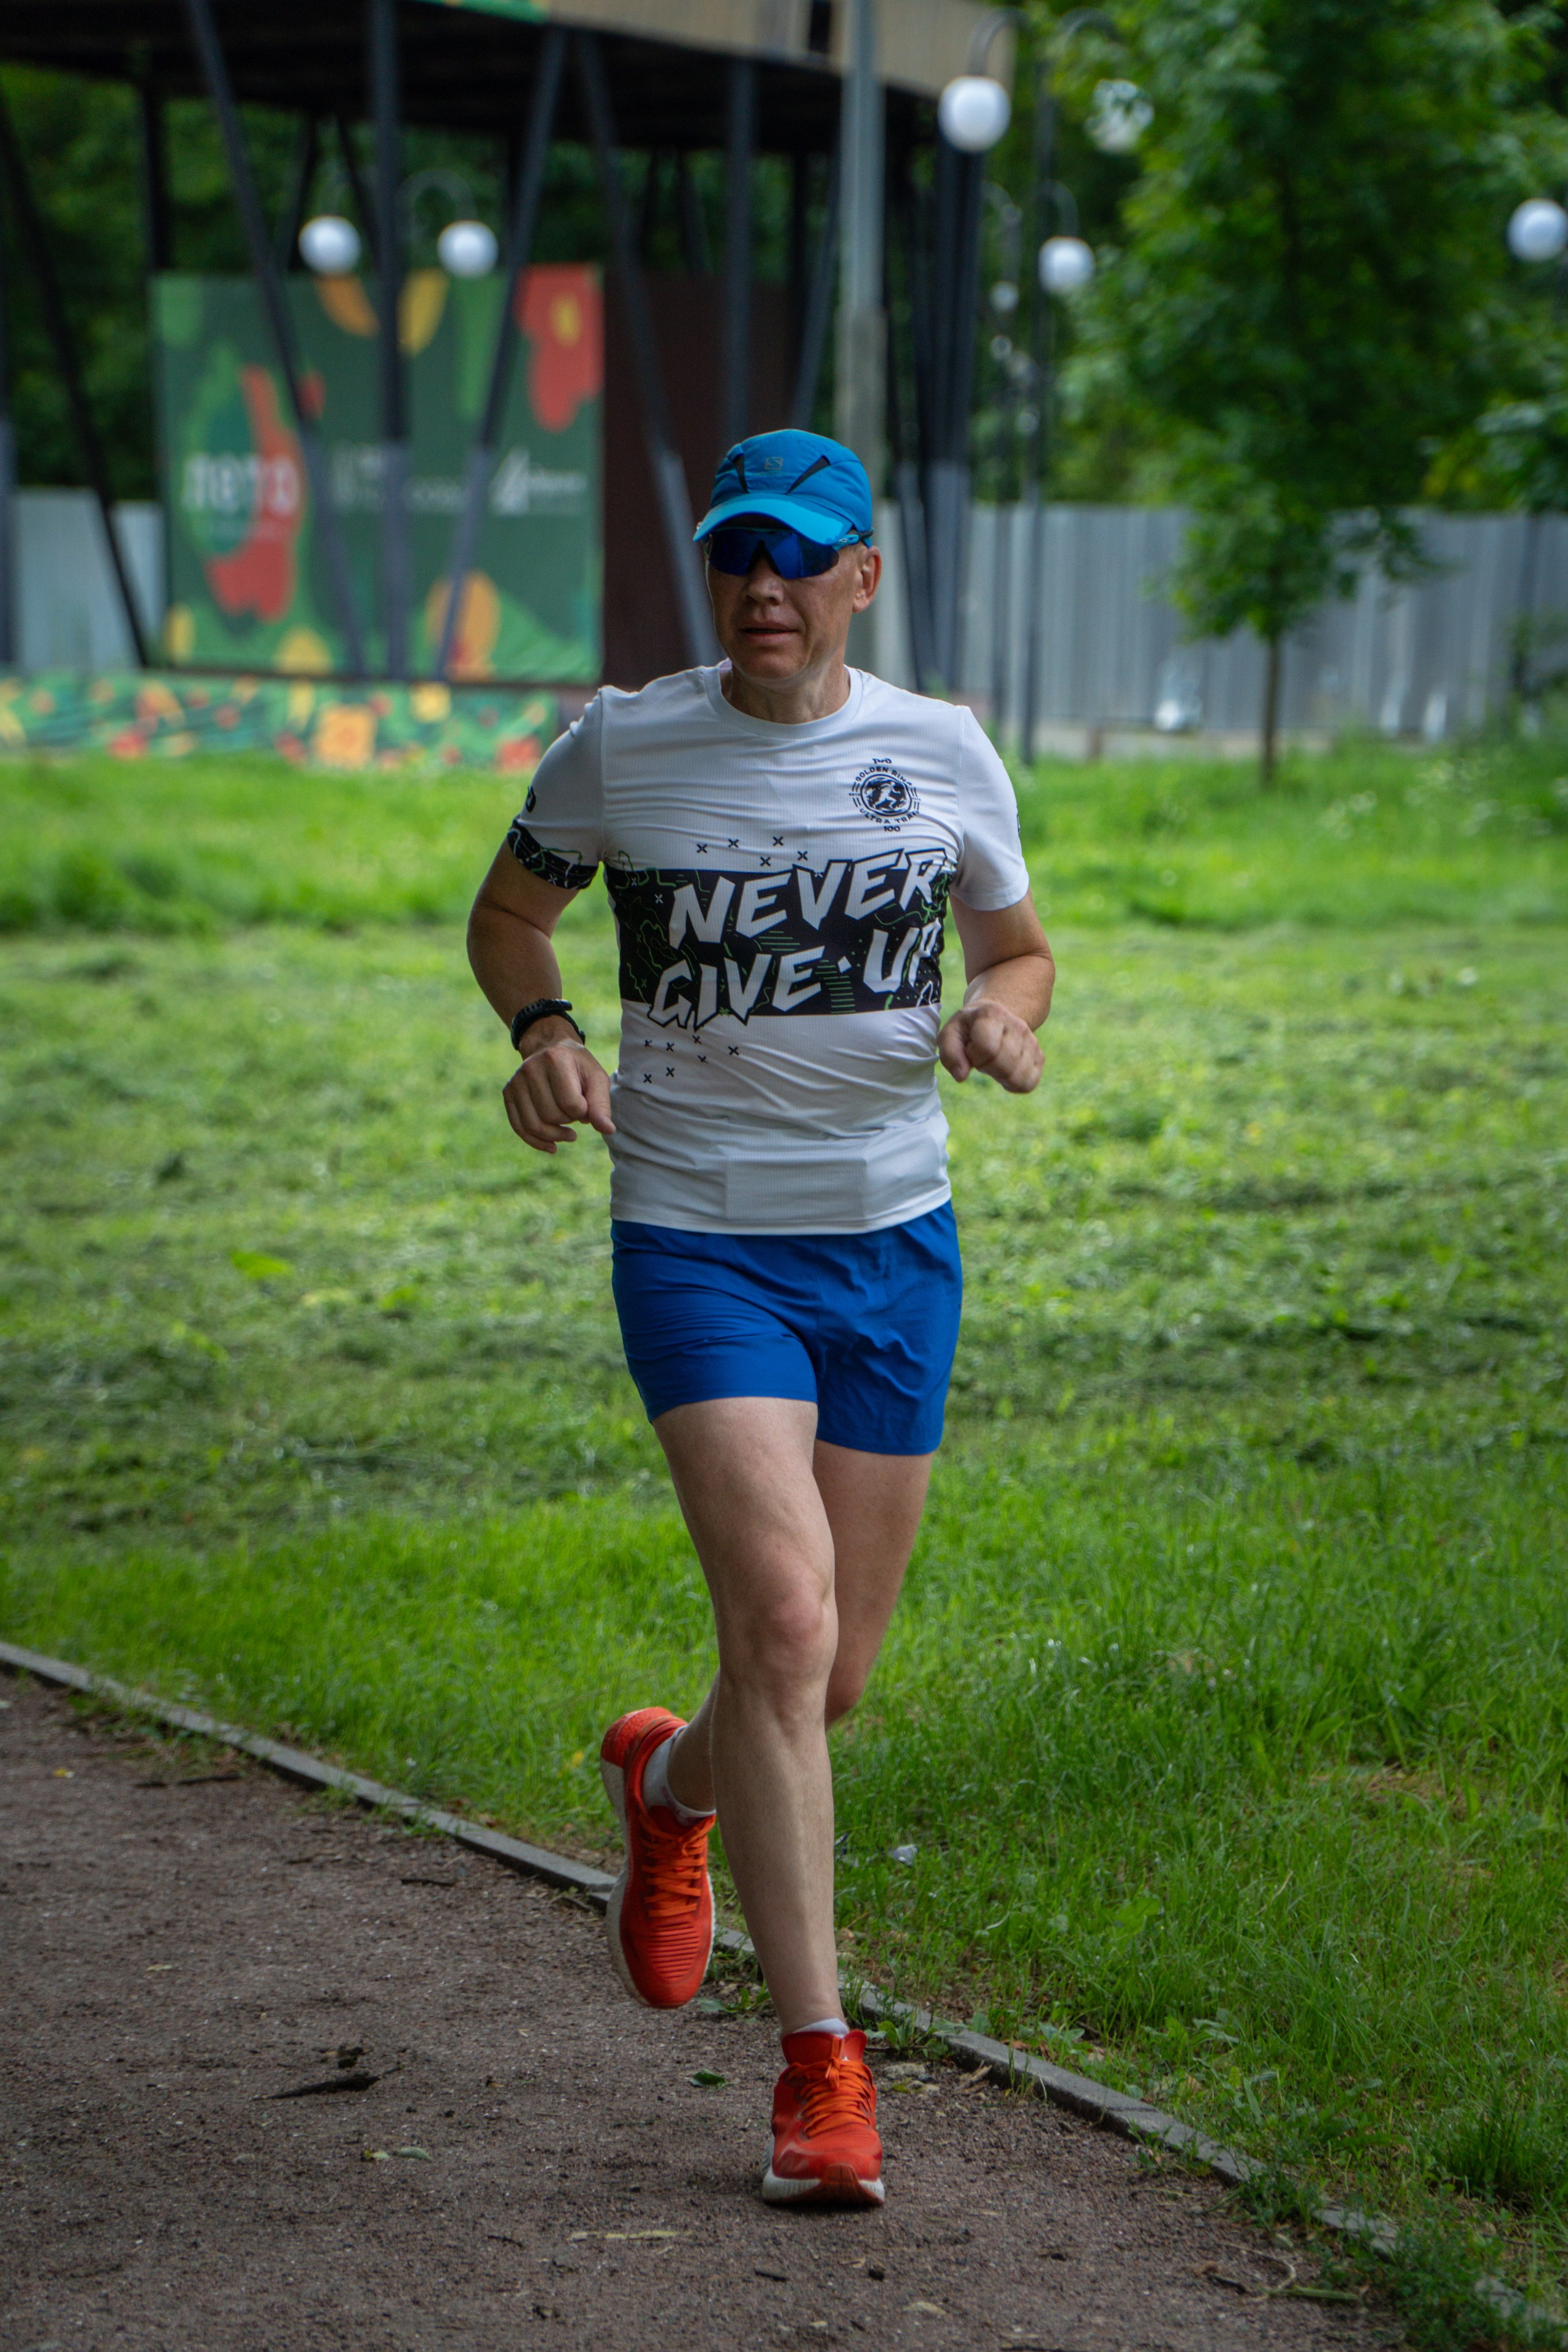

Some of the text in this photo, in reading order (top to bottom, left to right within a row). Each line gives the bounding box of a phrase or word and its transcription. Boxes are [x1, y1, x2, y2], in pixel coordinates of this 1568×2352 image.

[855, 766, 888, 782] GOLDEN
[859, 808, 891, 824] ULTRA
[669, 848, 947, 950] NEVER
[647, 946, 826, 1033] GIVE
